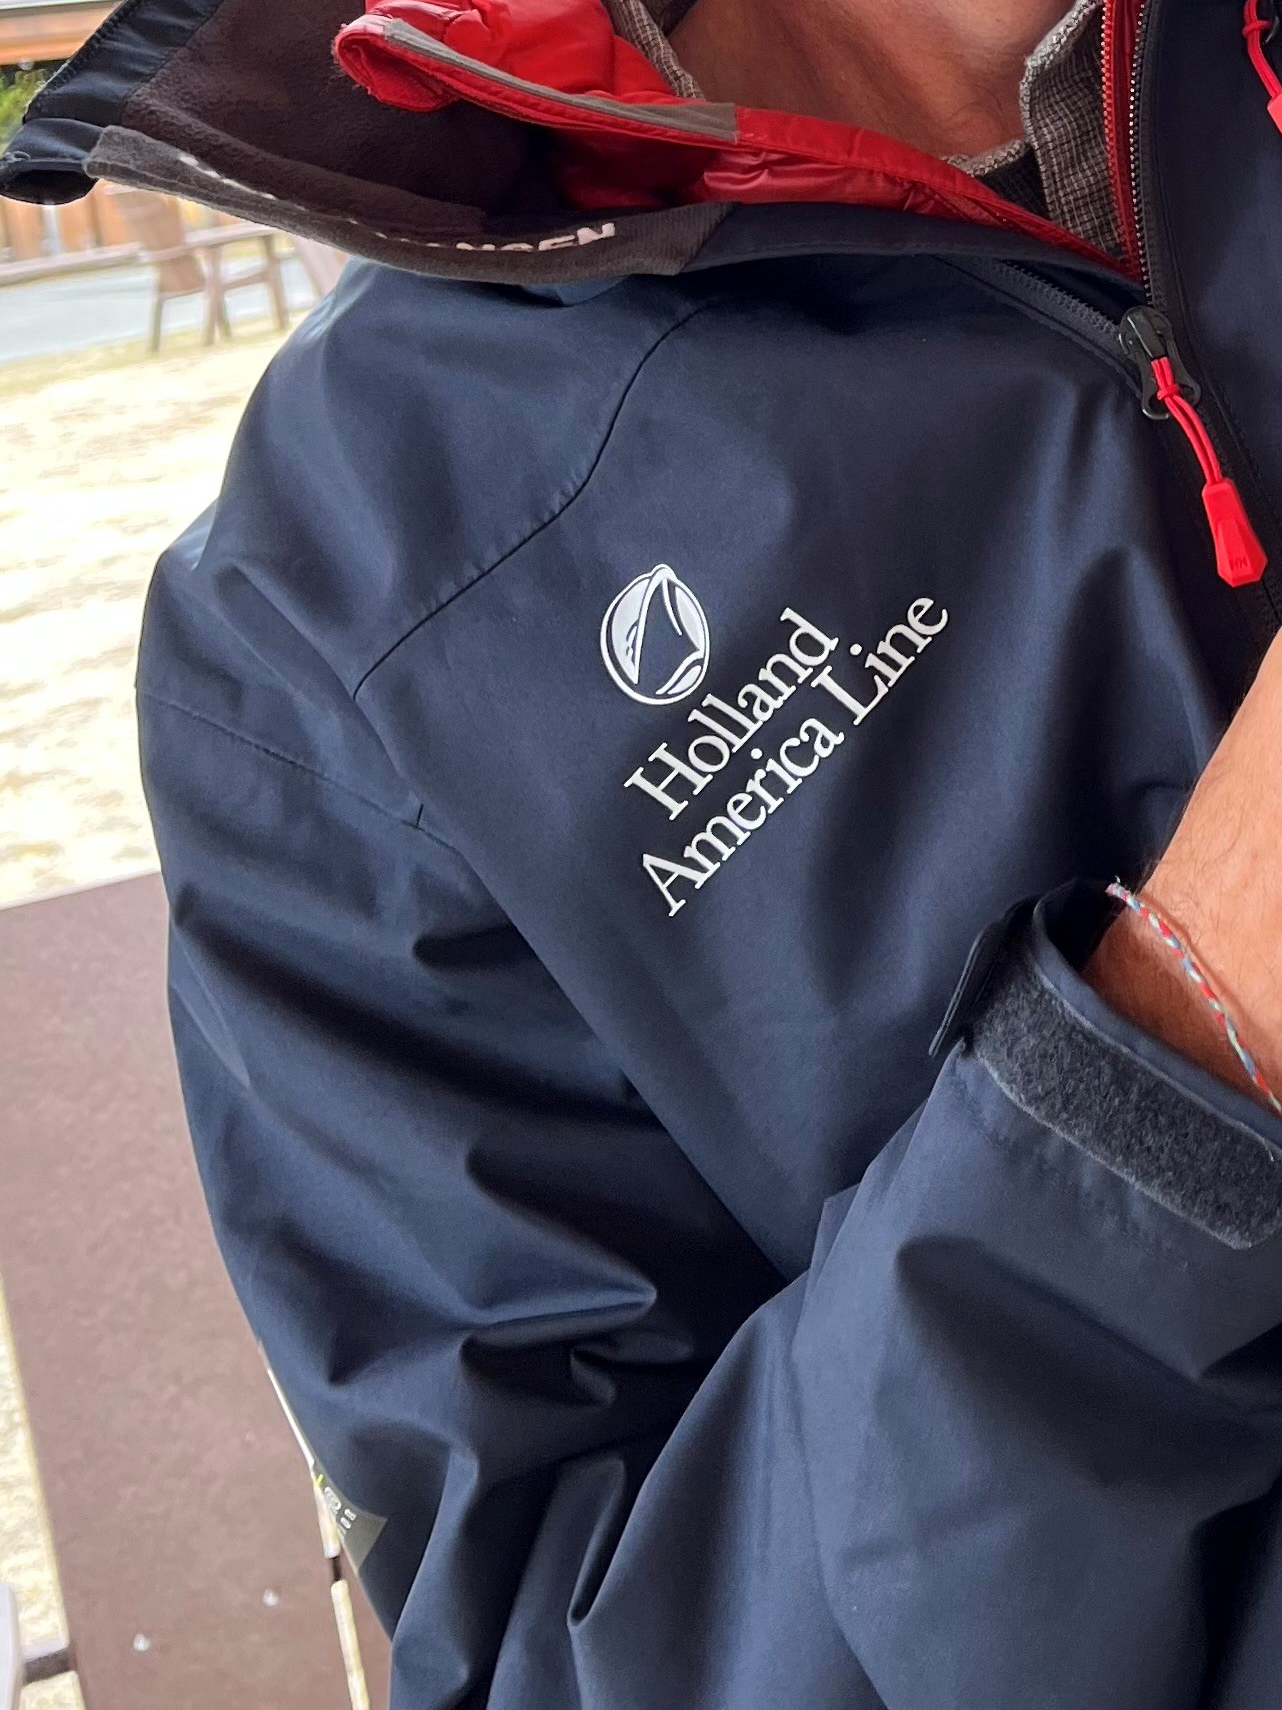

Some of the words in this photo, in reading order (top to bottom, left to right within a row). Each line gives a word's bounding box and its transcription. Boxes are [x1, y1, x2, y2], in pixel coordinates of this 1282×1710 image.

[623, 607, 839, 821] Holland
[642, 717, 845, 917] America
[810, 597, 948, 726] Line
